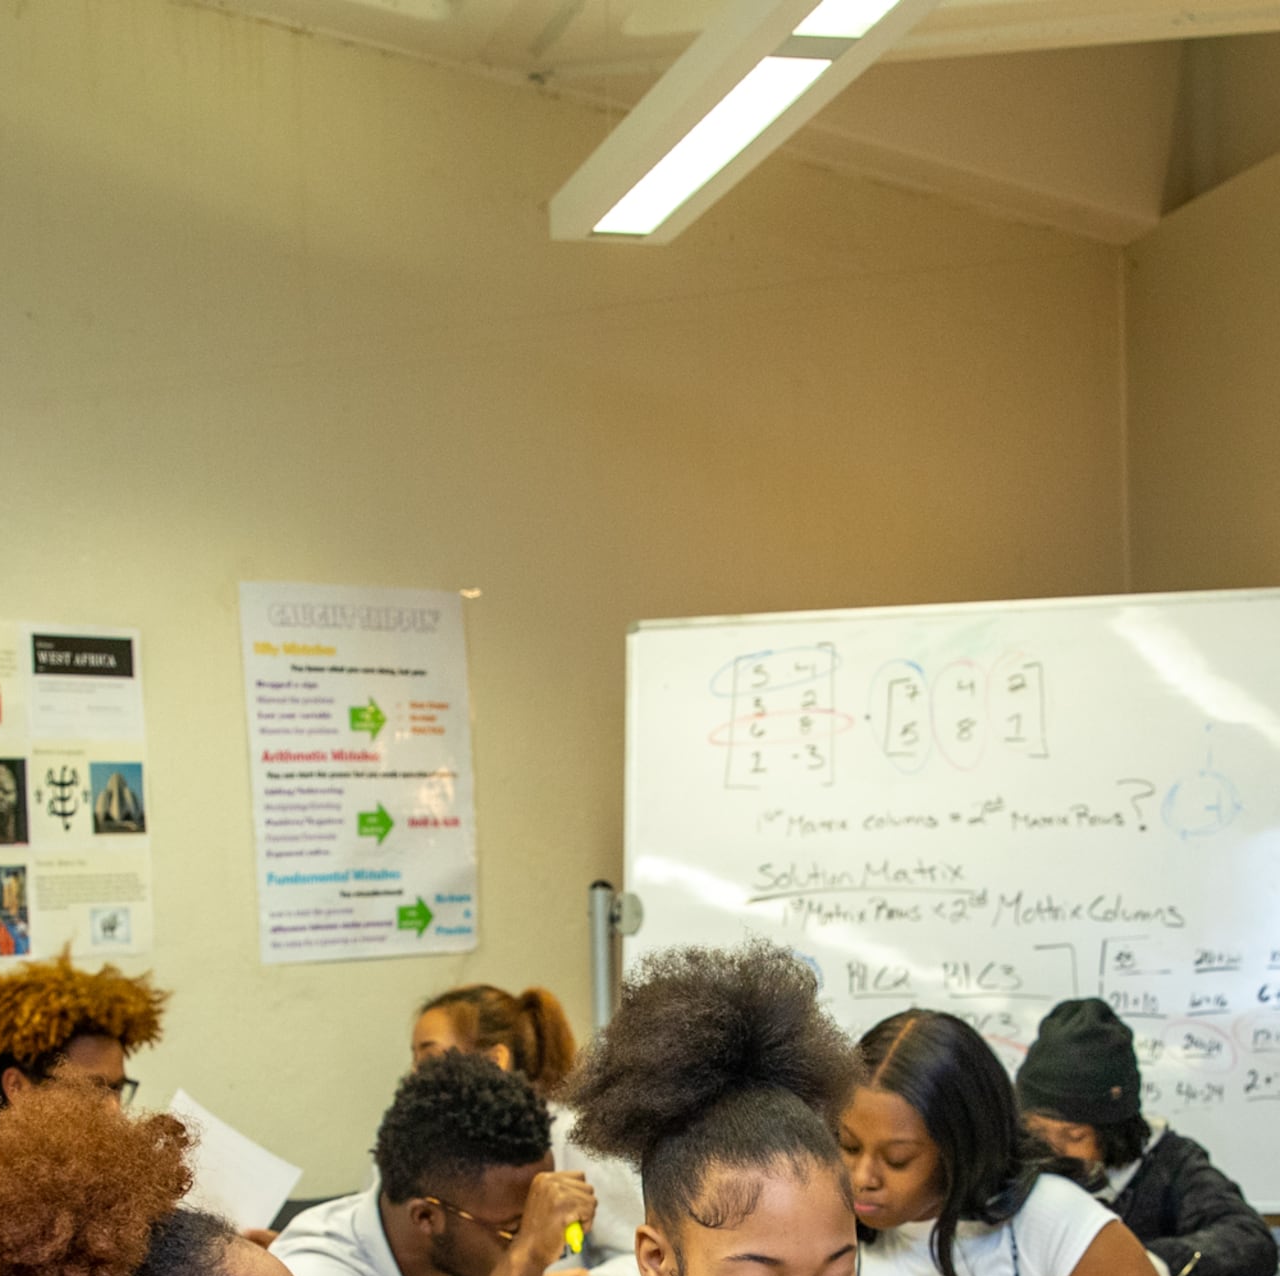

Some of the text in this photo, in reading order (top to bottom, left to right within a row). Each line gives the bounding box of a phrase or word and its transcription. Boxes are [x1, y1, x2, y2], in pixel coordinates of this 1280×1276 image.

[36, 649, 118, 669] WEST AFRICA
[956, 717, 977, 742] 8
[858, 855, 966, 888] Matrix
